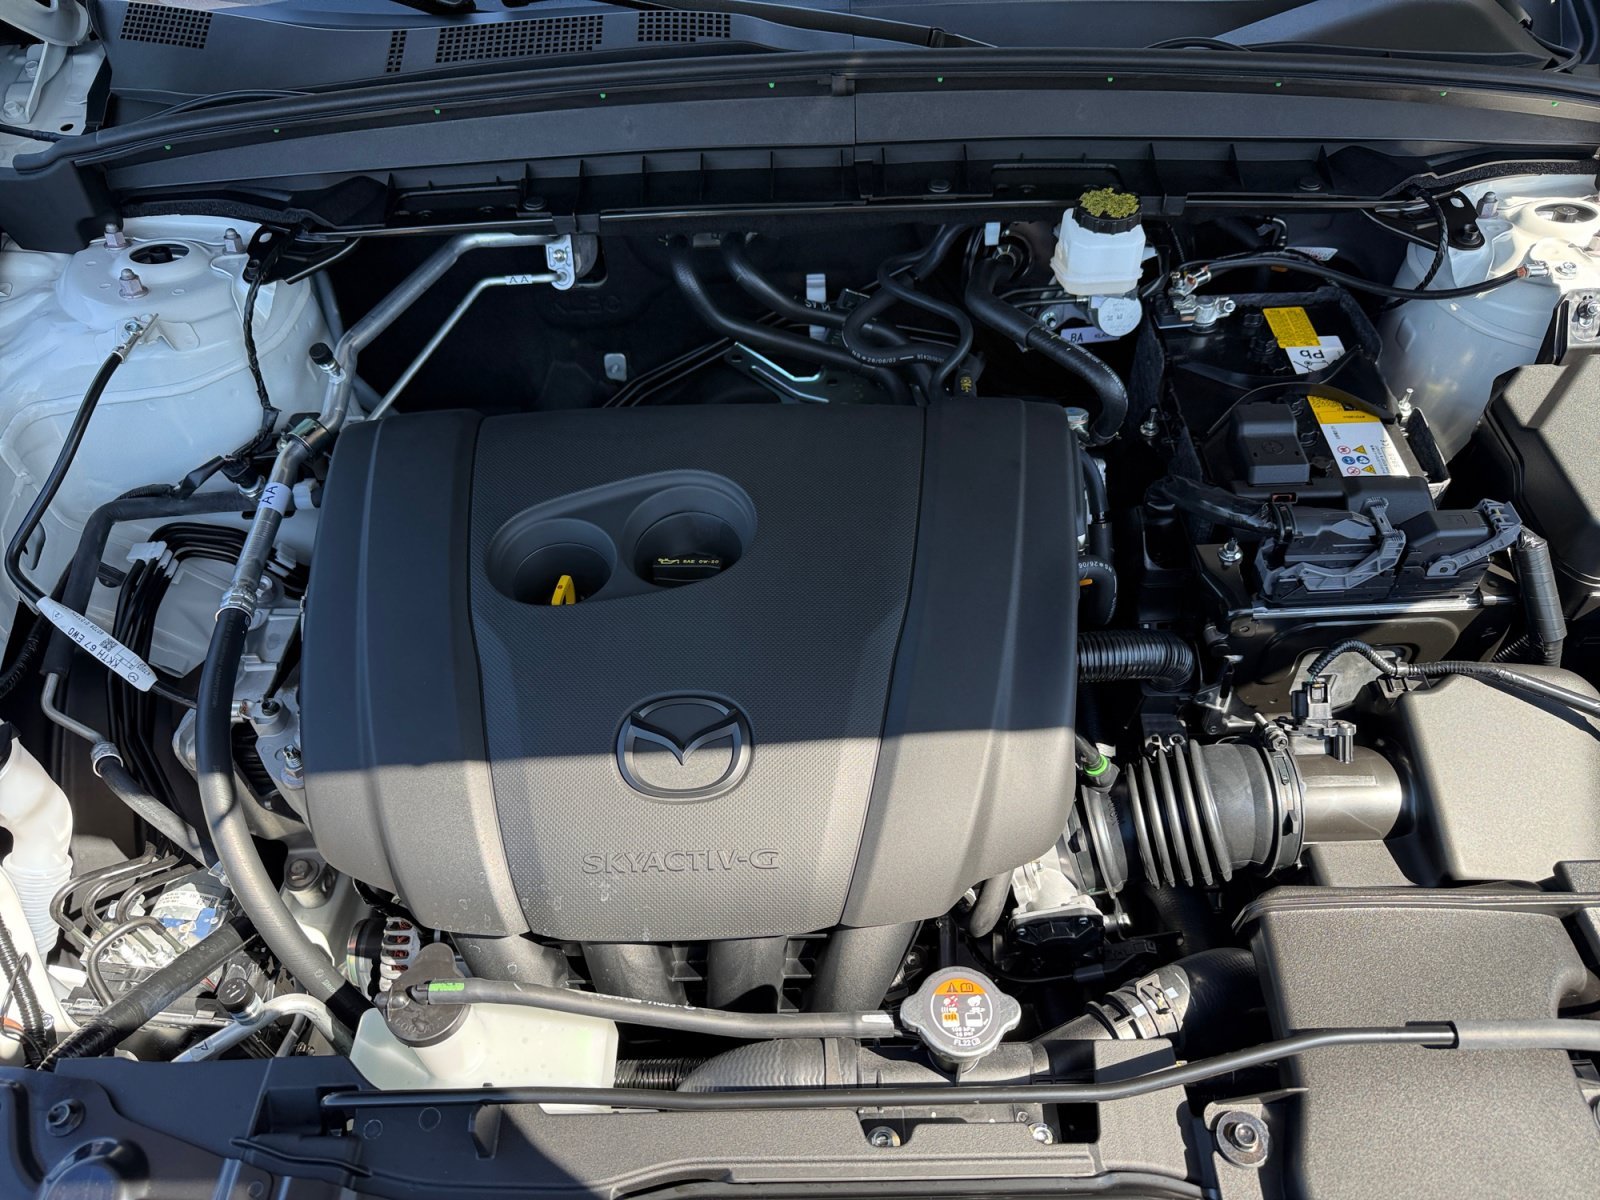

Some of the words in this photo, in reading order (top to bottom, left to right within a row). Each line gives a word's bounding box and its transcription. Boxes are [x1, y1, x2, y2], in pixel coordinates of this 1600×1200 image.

[509, 275, 529, 284] AA
[1070, 331, 1084, 343] BA
[1299, 349, 1325, 360] Pb
[261, 485, 279, 505] AA
[84, 641, 97, 651] 67
[97, 649, 119, 668] KKTH
[582, 848, 780, 874] SKYACTIV-G
[953, 1038, 971, 1046] FL22
